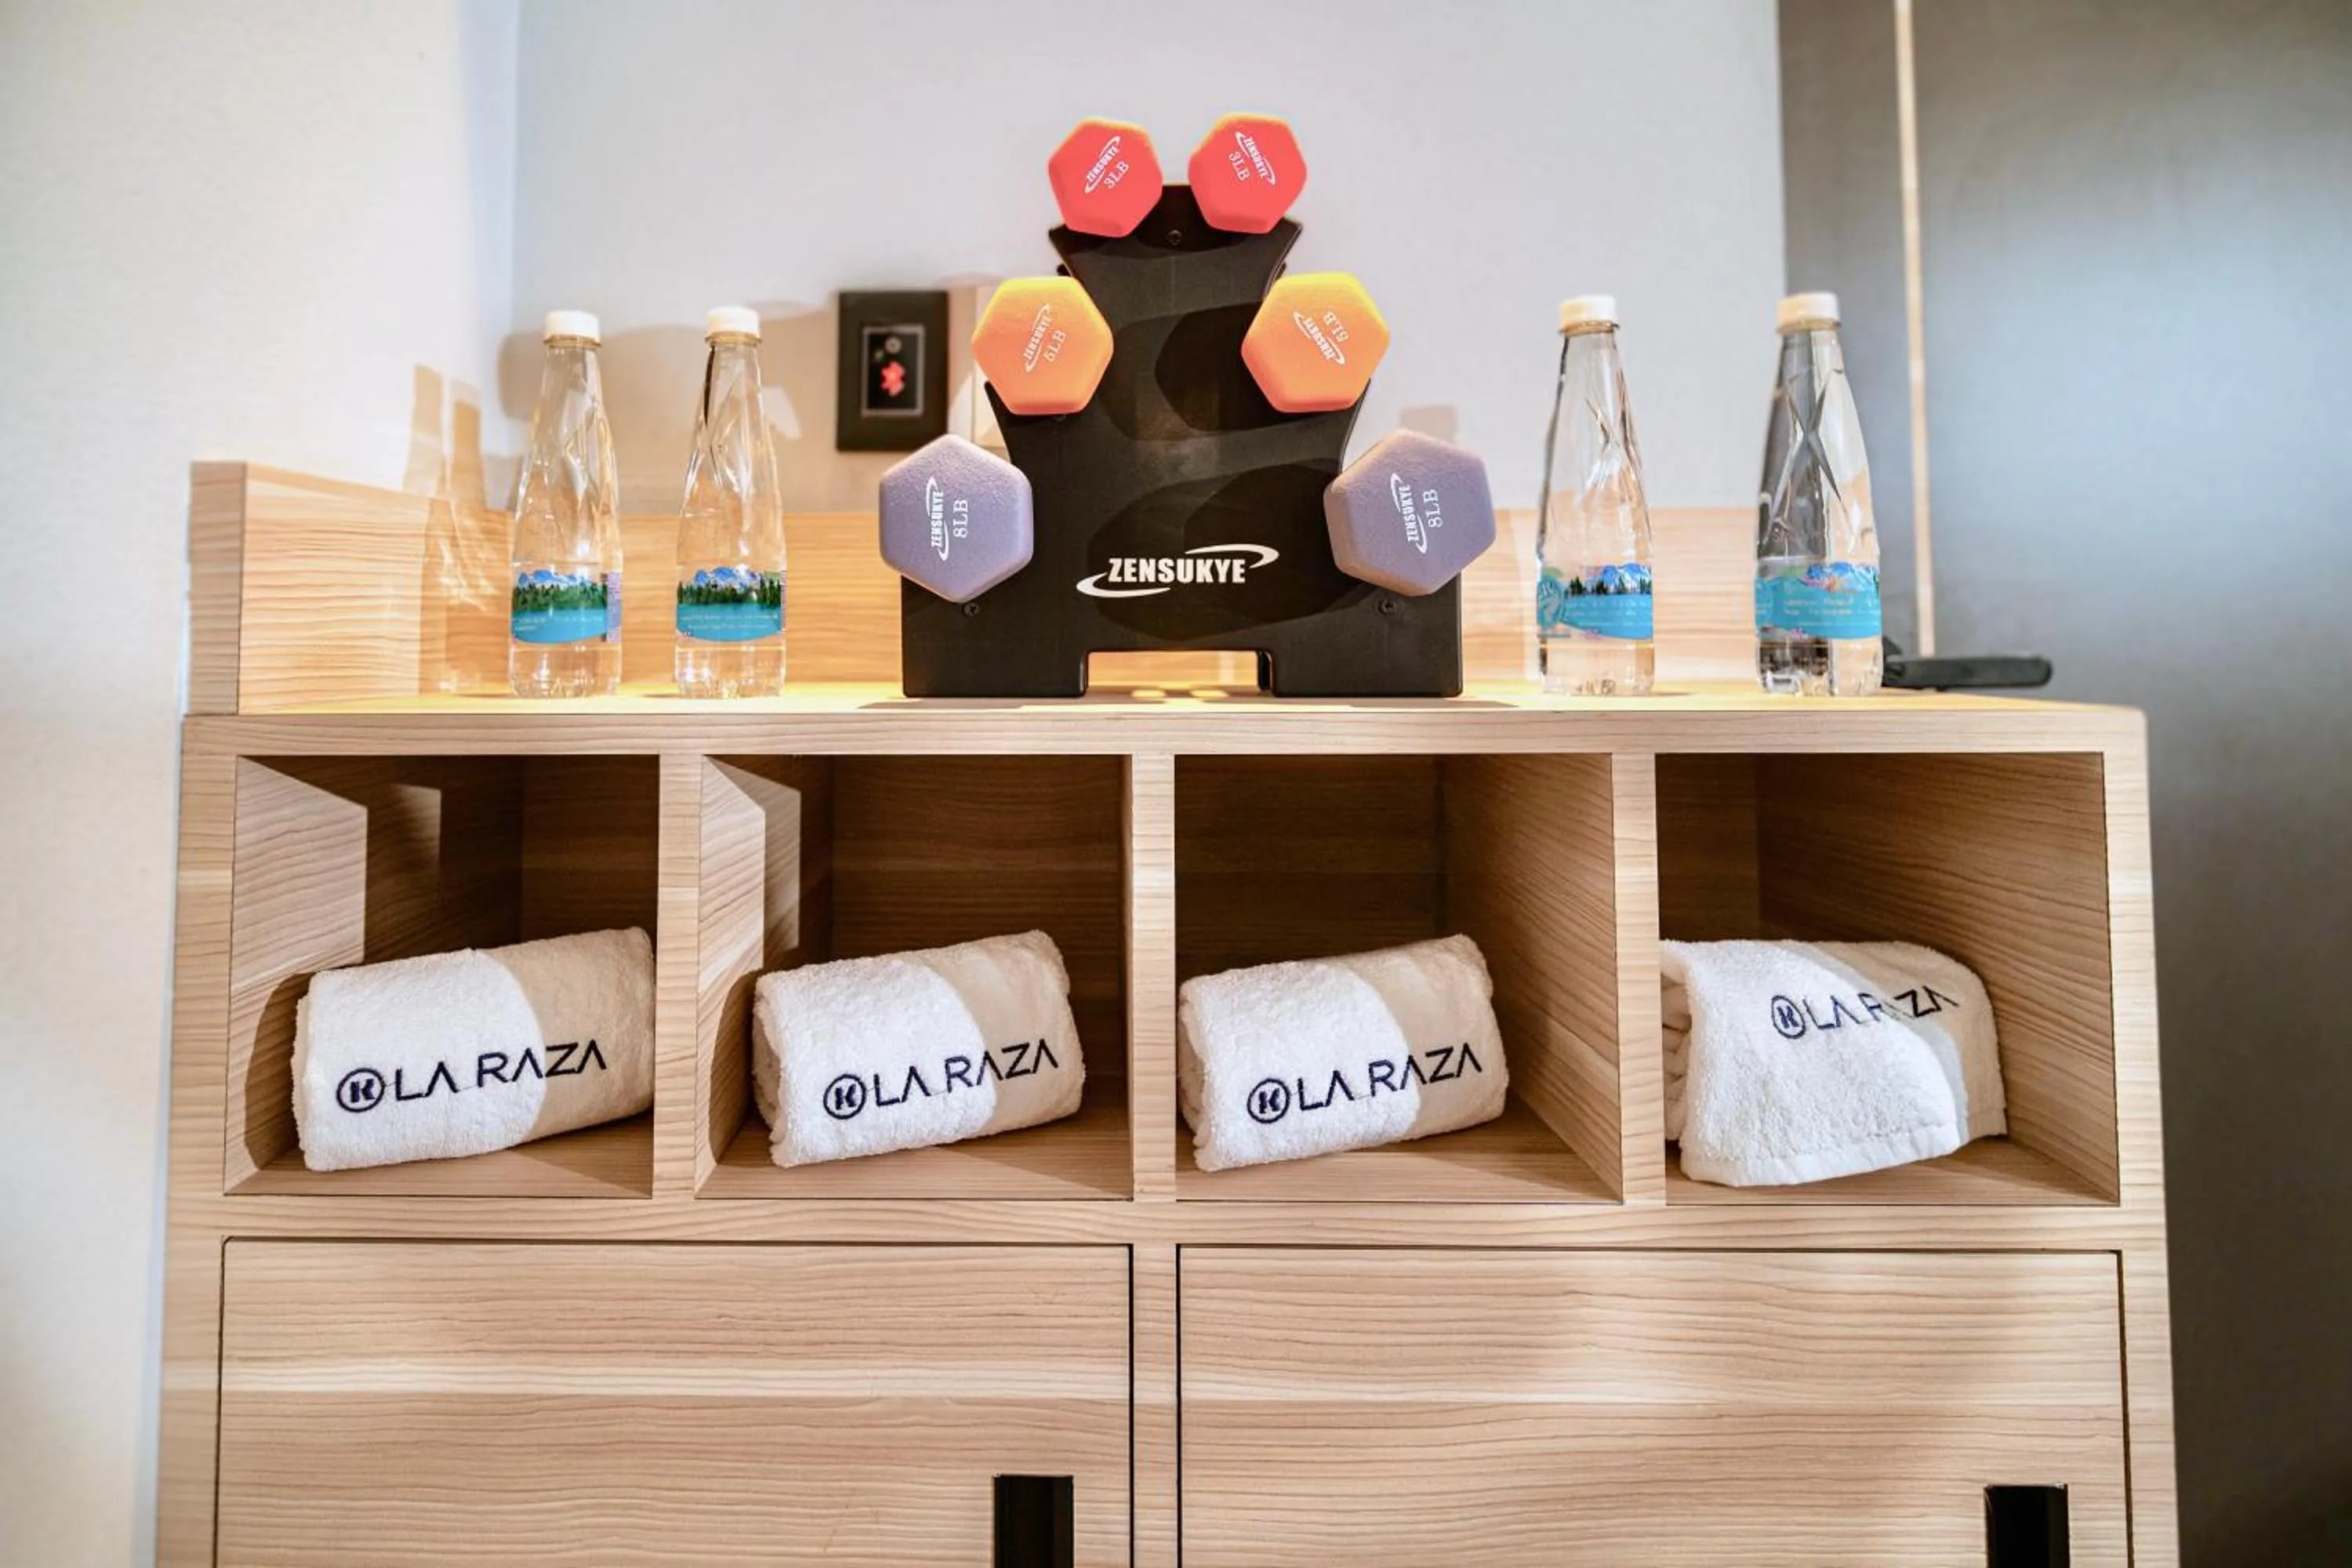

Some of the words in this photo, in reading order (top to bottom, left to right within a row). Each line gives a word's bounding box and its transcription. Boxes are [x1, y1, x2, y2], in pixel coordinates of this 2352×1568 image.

[1103, 161, 1130, 189] 3LB
[1229, 151, 1250, 181] 3LB
[1043, 330, 1067, 362] 5LB
[953, 499, 969, 539] 8LB
[1422, 488, 1443, 528] 8LB
[1107, 557, 1247, 583] ZENSUKYE
[1802, 995, 1863, 1030] LA
[395, 1061, 459, 1101] LA
[477, 1039, 608, 1088] RAZA
[873, 1065, 931, 1107] LA
[944, 1038, 1059, 1094] RAZA
[1297, 1069, 1355, 1111] LA
[1368, 1042, 1483, 1098] RAZA
